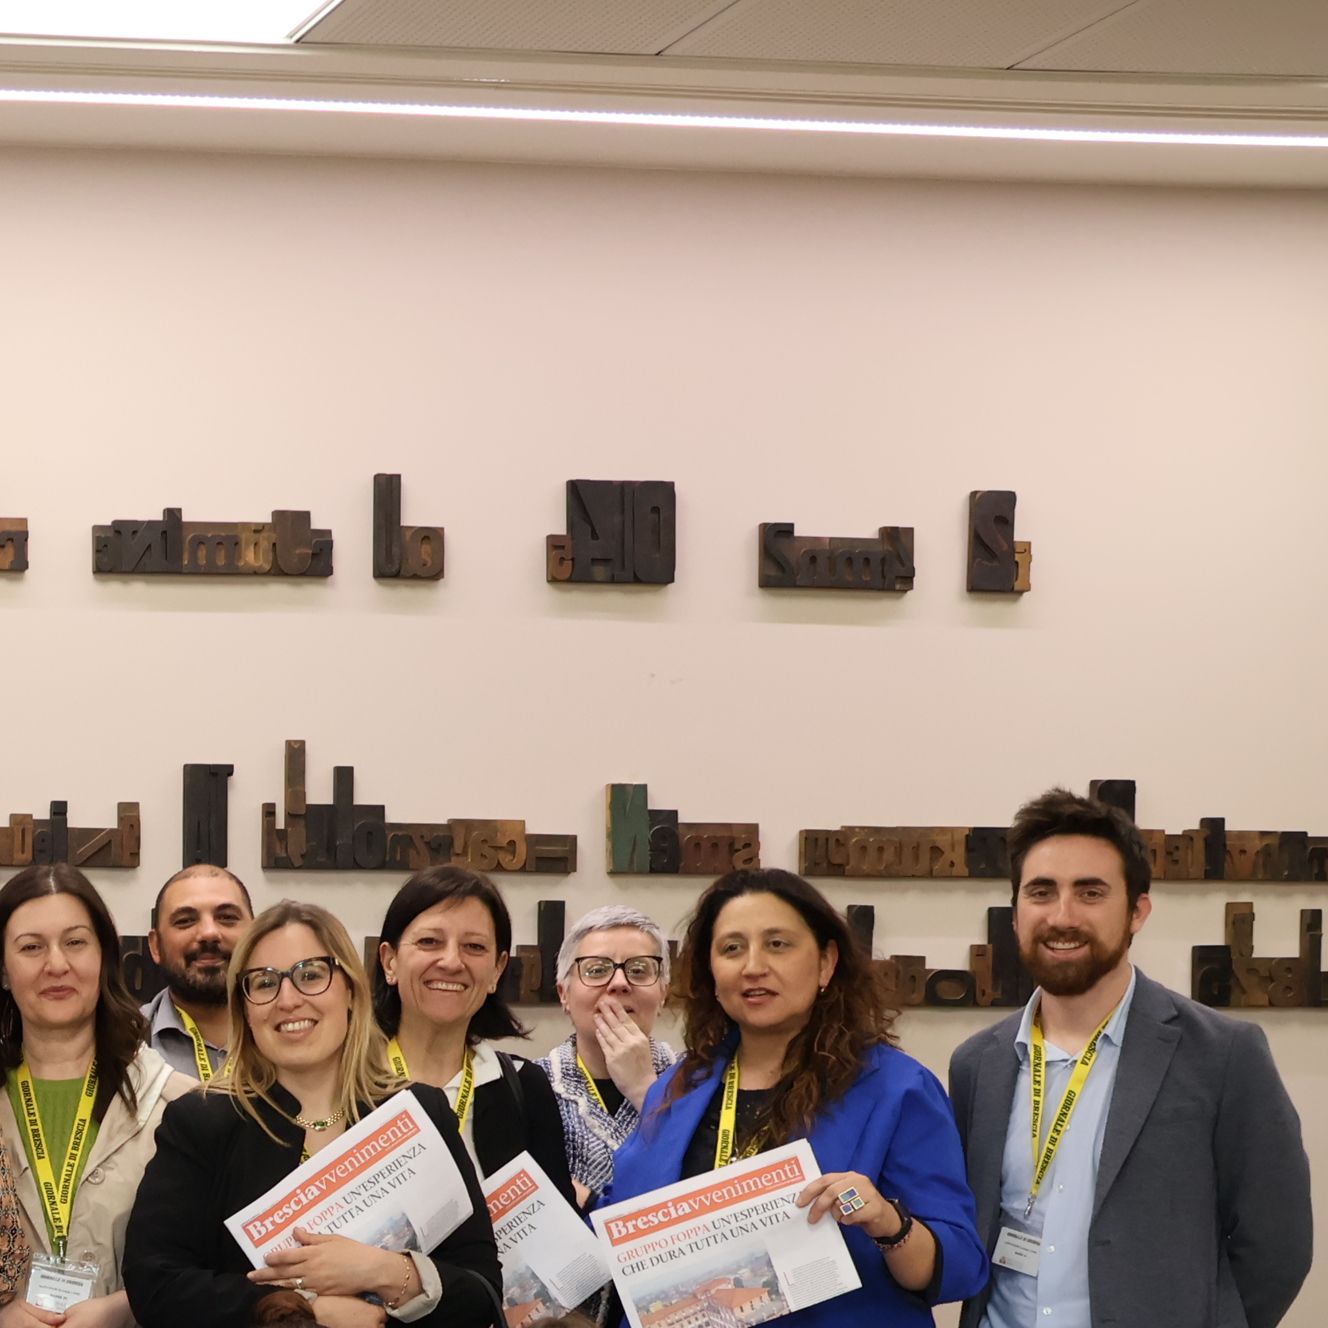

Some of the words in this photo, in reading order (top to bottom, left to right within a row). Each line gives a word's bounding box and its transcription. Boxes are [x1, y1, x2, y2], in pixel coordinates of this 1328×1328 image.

[1033, 1044, 1042, 1087] GIORNALE
[21, 1080, 36, 1118] GIORNALE
[31, 1127, 45, 1160] BRESCIA
[1054, 1090, 1075, 1136] GIORNALE
[60, 1163, 76, 1205] GIORNALE
[72, 1118, 87, 1153] BRESCIA
[247, 1115, 414, 1241] Bresciavvenimenti
[308, 1202, 345, 1232] FOPPA
[343, 1142, 427, 1204] UN'ESPERIENZA
[44, 1181, 61, 1224] GIORNALE
[328, 1205, 365, 1235] TUTTA
[364, 1188, 390, 1209] UNA
[389, 1168, 416, 1189] VITA
[610, 1160, 801, 1240] Bresciavvenimenti
[513, 1223, 537, 1245] VITA
[617, 1237, 668, 1264] GRUPPO
[671, 1224, 710, 1249] FOPPA
[622, 1260, 649, 1277] CHE
[651, 1246, 685, 1268] DURA
[685, 1233, 729, 1258] TUTTA
[730, 1223, 758, 1239] UNA
[760, 1213, 791, 1231] VITA
